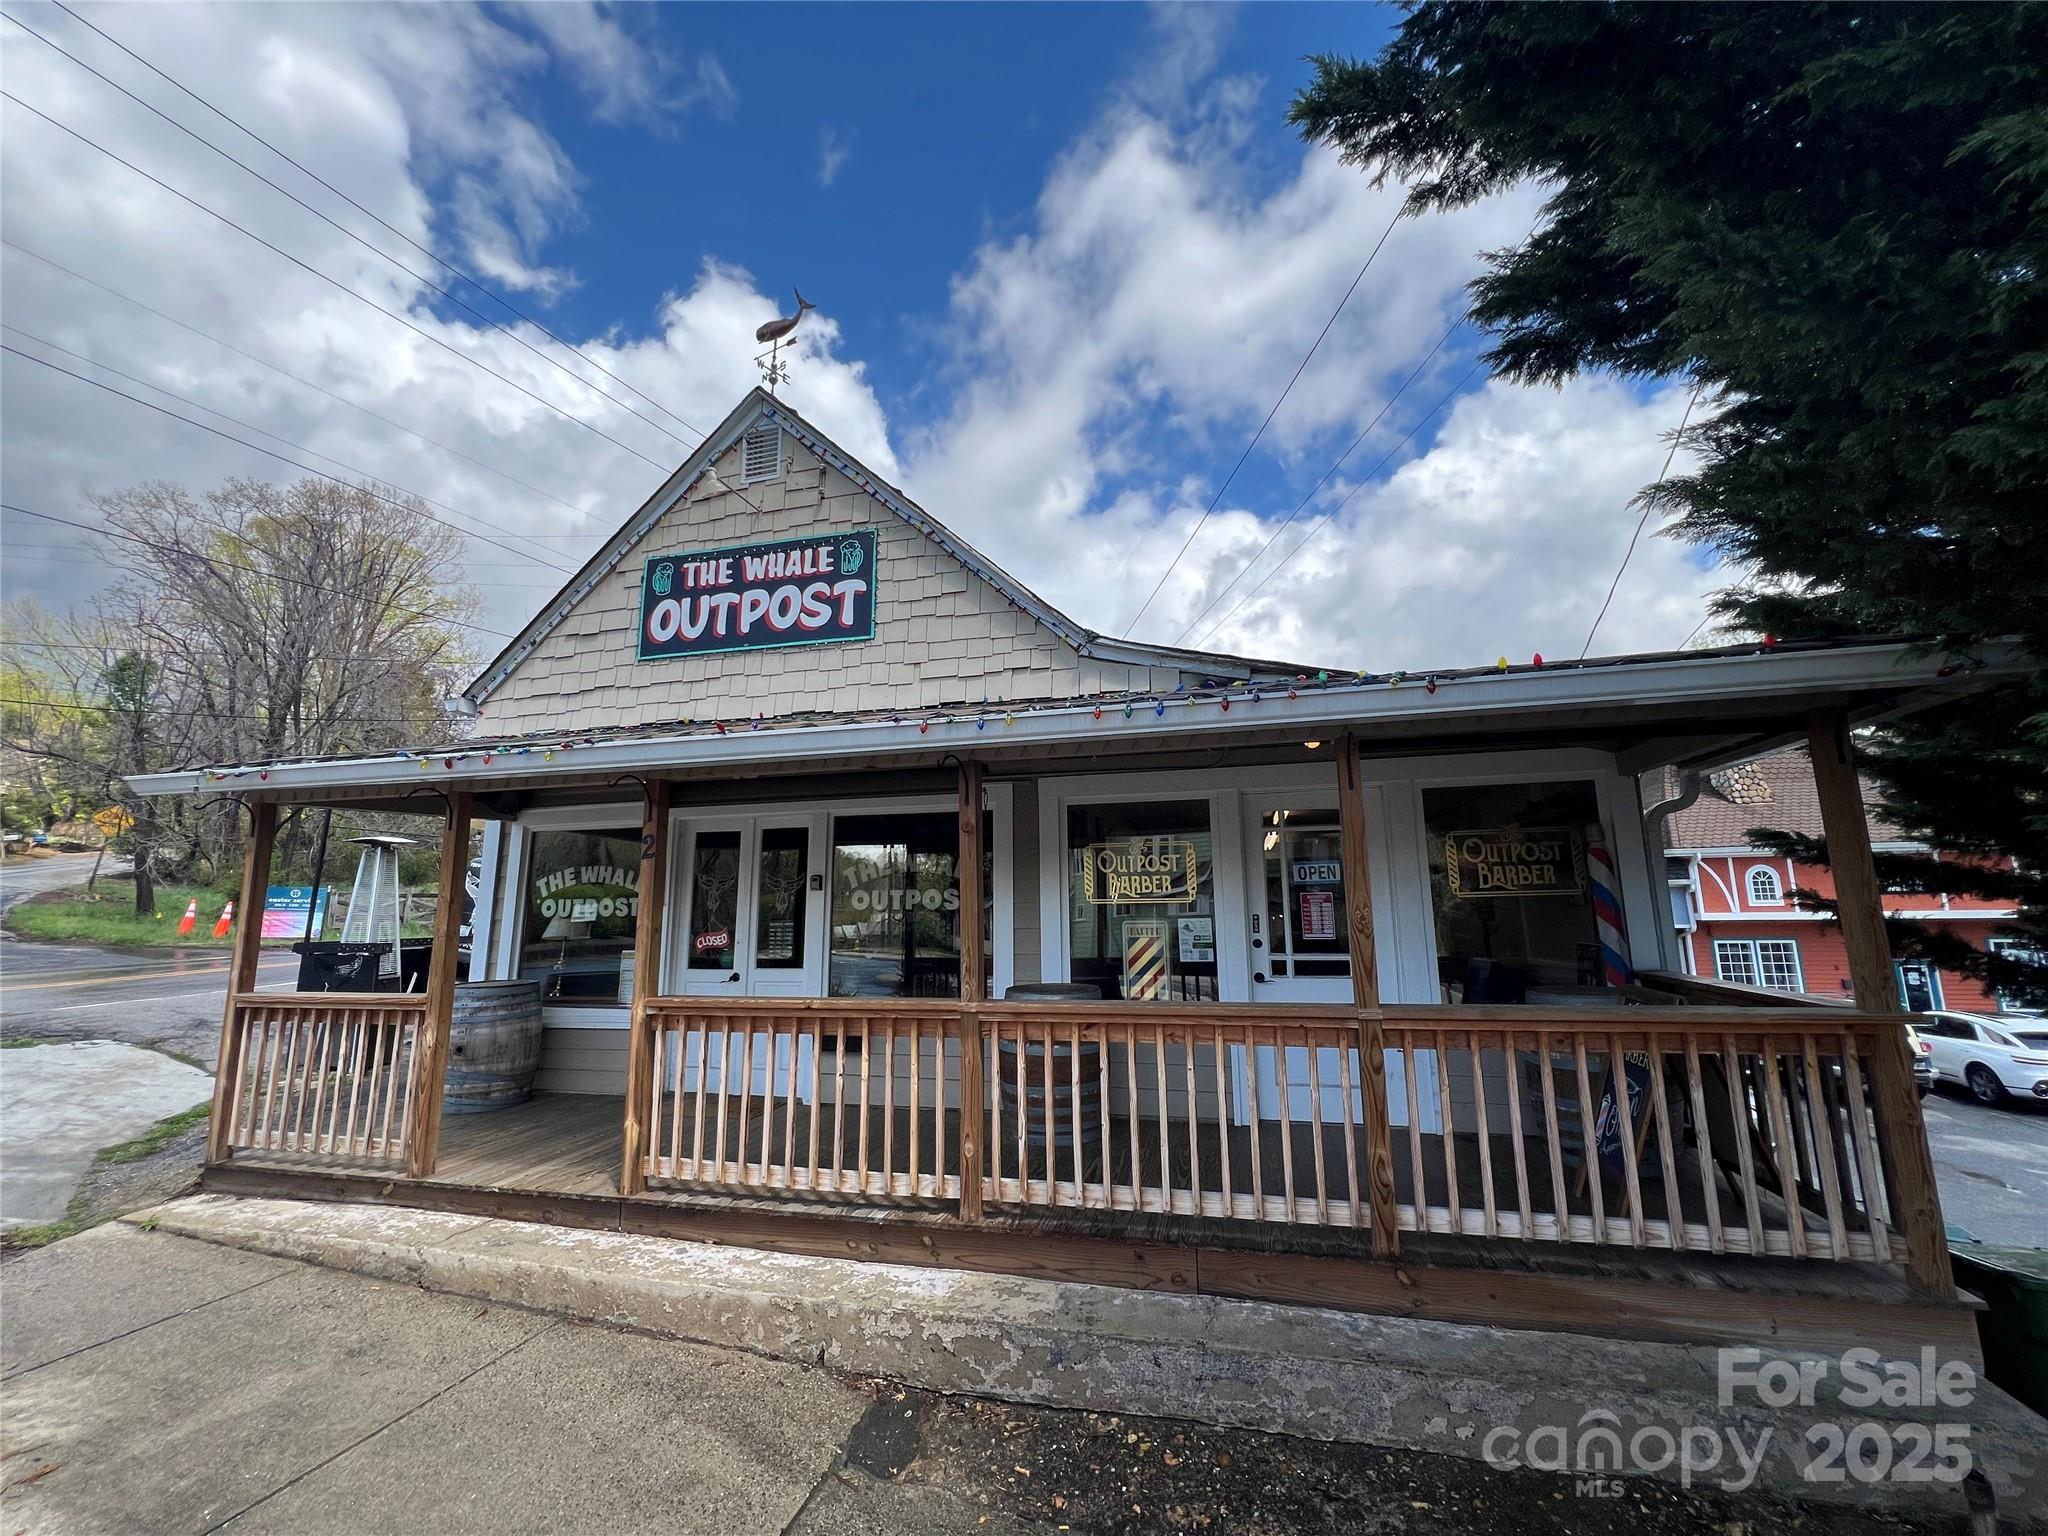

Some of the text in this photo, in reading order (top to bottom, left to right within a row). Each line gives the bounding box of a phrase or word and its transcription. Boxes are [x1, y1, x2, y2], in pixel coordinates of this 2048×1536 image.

[682, 546, 835, 589] THE WHALE
[647, 579, 867, 644] OUTPOST
[641, 834, 656, 860] 2
[536, 865, 641, 898] THE WHAL
[1107, 872, 1172, 897] BARBER
[1297, 865, 1336, 880] OPEN
[1477, 862, 1556, 889] BARBER
[851, 888, 960, 911] OUTPOS
[697, 933, 728, 949] CLOSED
